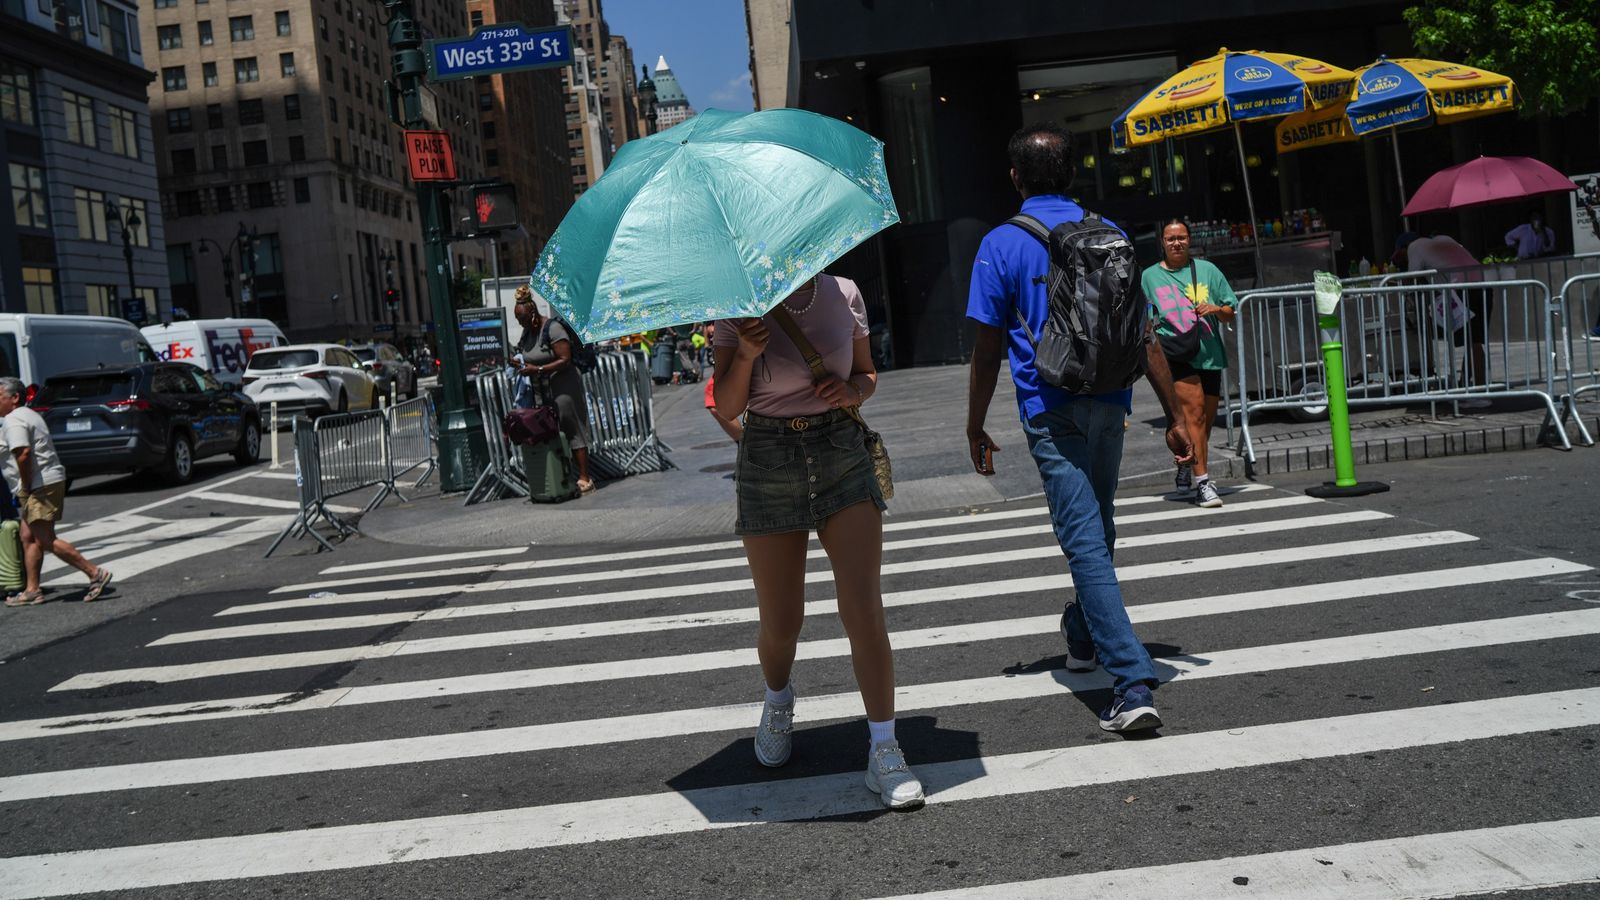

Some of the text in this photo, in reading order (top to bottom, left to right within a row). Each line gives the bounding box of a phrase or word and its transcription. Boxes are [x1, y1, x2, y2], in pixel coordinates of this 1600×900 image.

[481, 28, 519, 40] 271 201
[443, 38, 561, 68] West 33rd St
[1432, 85, 1509, 108] SABRETT
[1133, 102, 1220, 137] SABRETT
[1280, 118, 1342, 147] SABRETT
[415, 138, 444, 153] RAISE
[420, 158, 447, 173] PLOW
[155, 341, 194, 361] edEx
